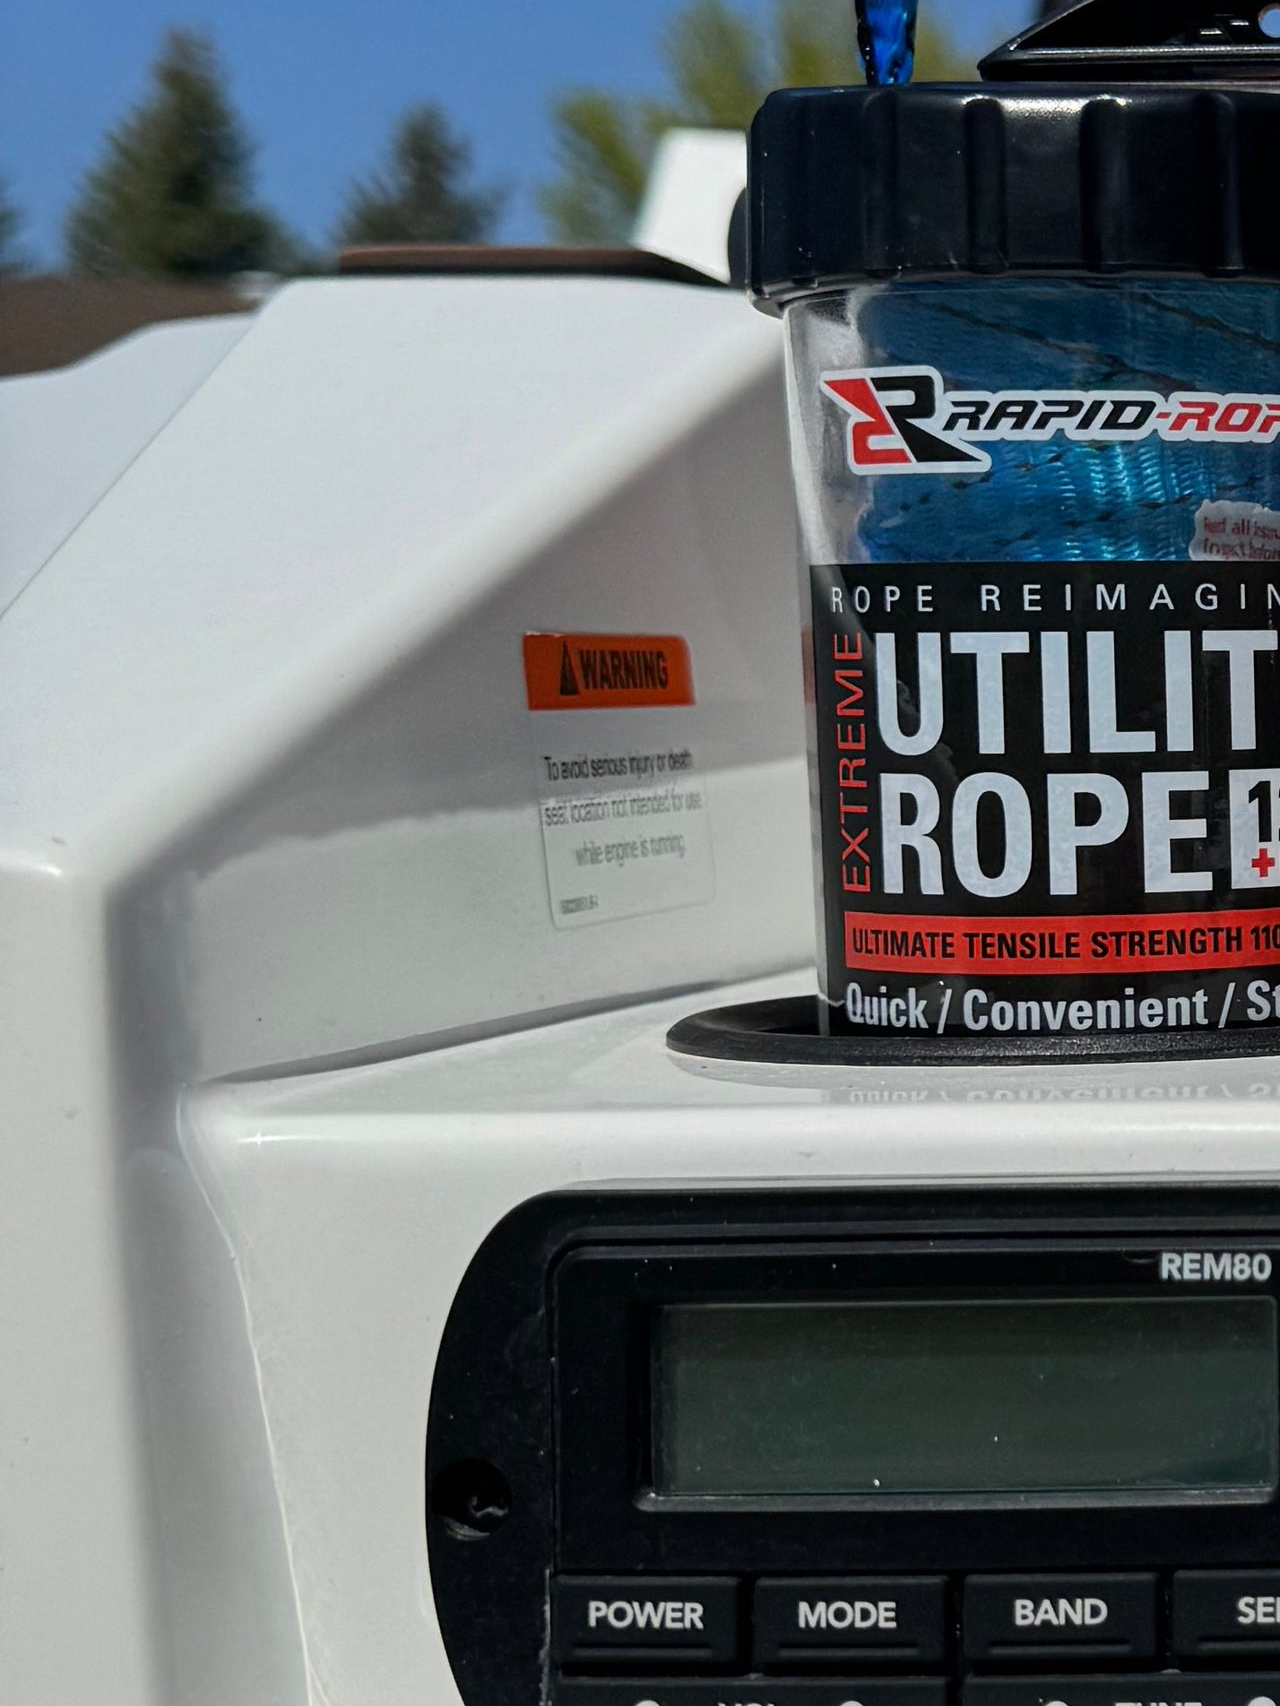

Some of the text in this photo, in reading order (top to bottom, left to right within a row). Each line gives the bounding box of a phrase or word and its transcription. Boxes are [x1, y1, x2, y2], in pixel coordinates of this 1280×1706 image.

[831, 586, 933, 614] ROPE
[578, 648, 669, 690] WARNING
[544, 756, 559, 781] To
[561, 756, 589, 779] avoid
[833, 633, 871, 893] EXTREME
[880, 770, 1213, 899] ROPE
[852, 929, 955, 960] ULTIMATE
[963, 931, 1080, 961] TENSILE
[1091, 926, 1241, 958] STRENGTH
[846, 981, 929, 1030] Quick
[963, 987, 1208, 1032] Convenient
[1162, 1252, 1272, 1282] REM80
[588, 1601, 704, 1631] POWER
[798, 1601, 897, 1631] MODE
[1014, 1598, 1108, 1627] BAND
